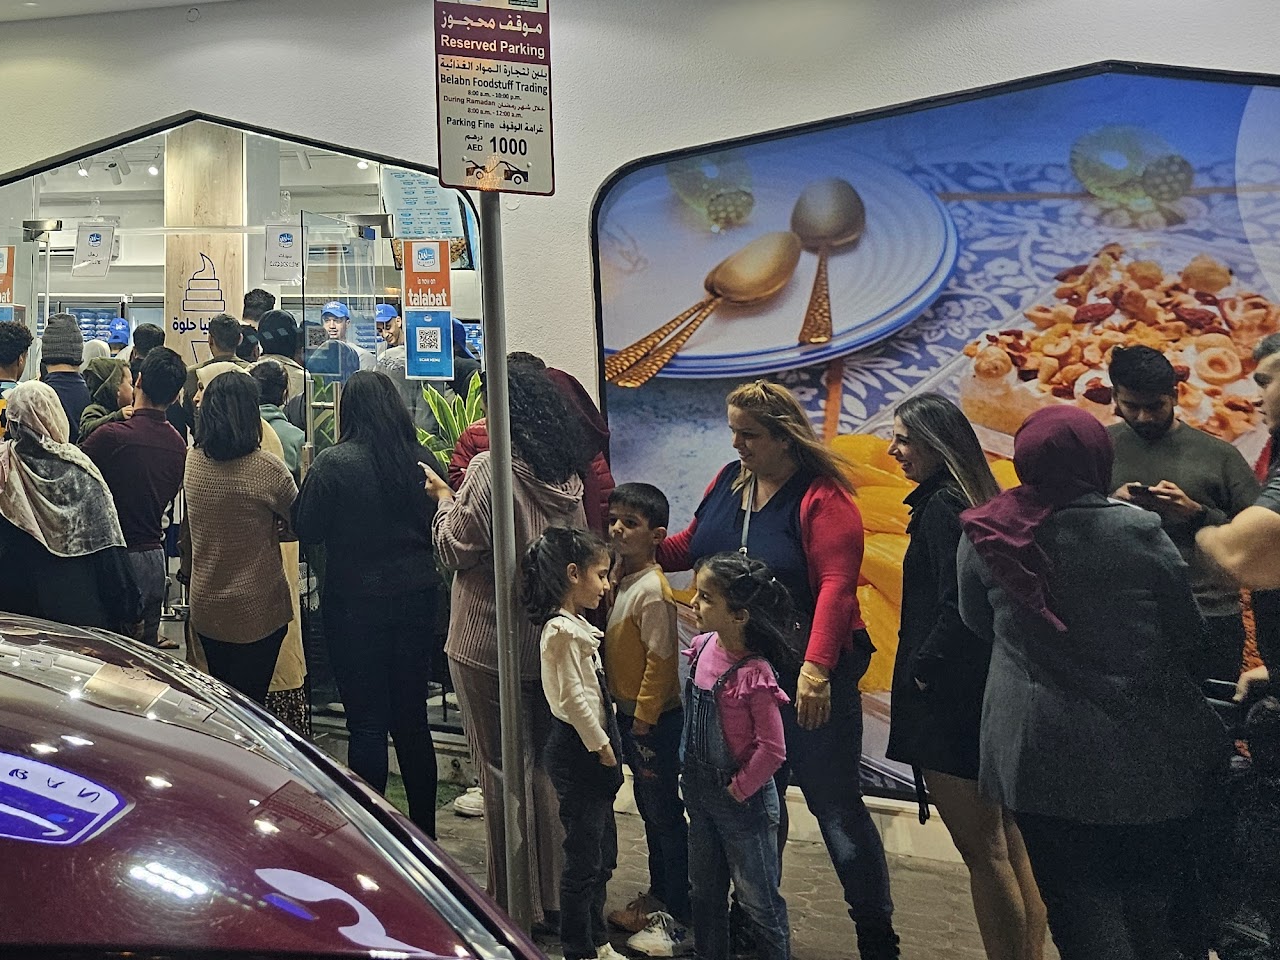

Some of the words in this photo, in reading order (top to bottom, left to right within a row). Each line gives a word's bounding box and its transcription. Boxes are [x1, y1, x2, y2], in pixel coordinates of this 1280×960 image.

[441, 10, 496, 31] محجوز
[499, 15, 543, 37] موقف
[440, 34, 497, 52] Reserved
[500, 40, 545, 60] Parking
[440, 57, 473, 72] الغذائية
[475, 62, 502, 75] المواد
[503, 65, 530, 78] لتجارة
[440, 74, 471, 86] Belabn
[473, 78, 515, 91] Foodstuff
[516, 81, 548, 96] Trading
[443, 95, 465, 104] During
[466, 97, 496, 107] Ramadan
[446, 116, 476, 129] Parking
[478, 119, 495, 129] Fine
[499, 120, 523, 132] الوقوف
[524, 123, 544, 134] غرامة
[464, 133, 483, 142] درهم
[466, 143, 483, 152] AED
[489, 136, 528, 156] 1000
[407, 287, 448, 306] talabat
[172, 316, 197, 335] حلوة
